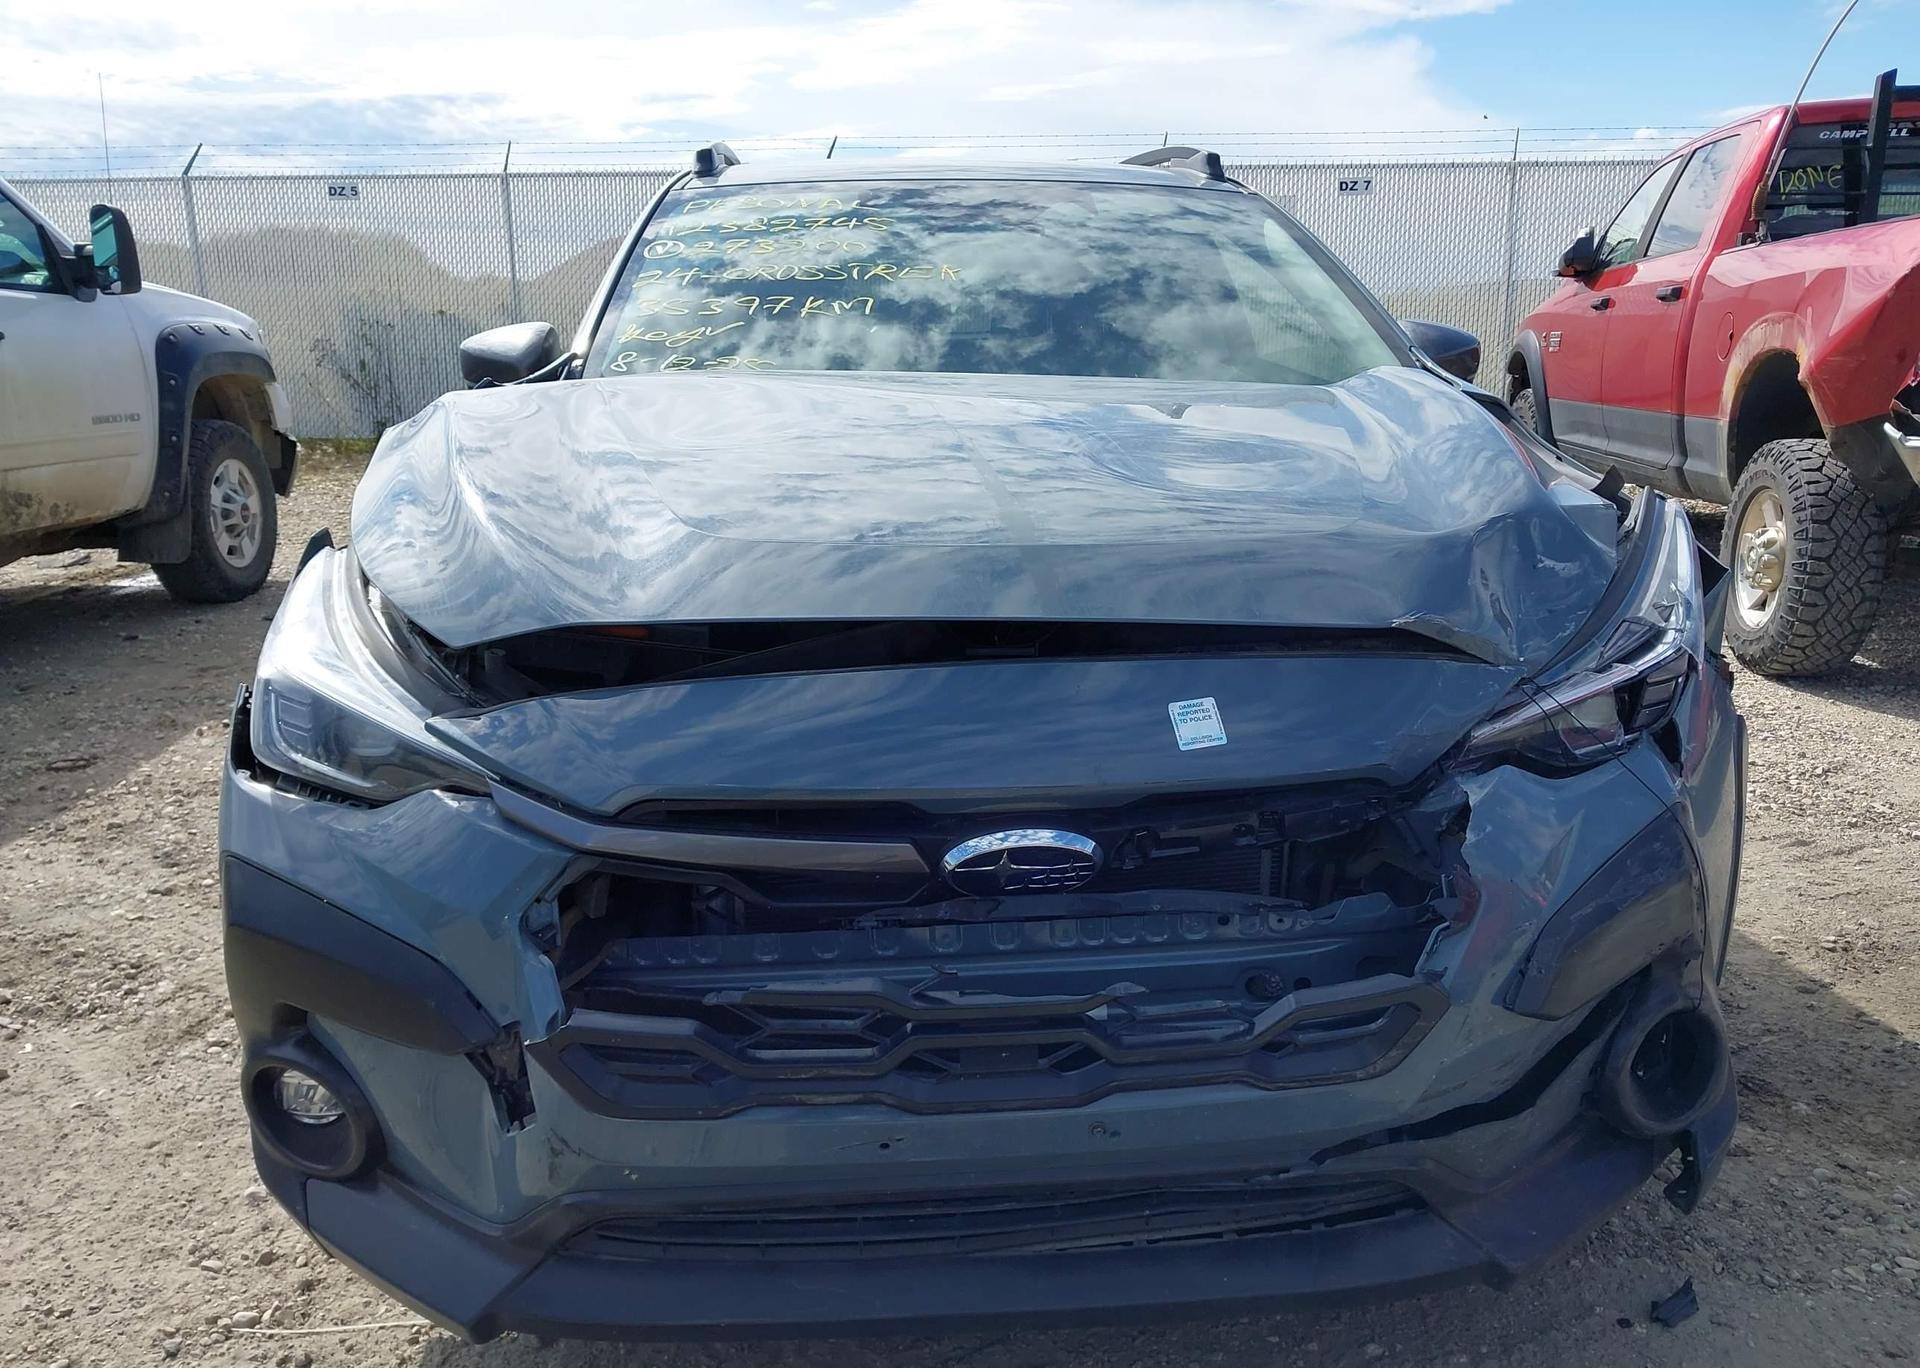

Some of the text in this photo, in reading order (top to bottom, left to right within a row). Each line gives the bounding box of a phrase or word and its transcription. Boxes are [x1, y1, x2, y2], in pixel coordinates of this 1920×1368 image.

[1819, 128, 1911, 139] CAMPLL
[1778, 164, 1842, 193] DONE
[1339, 180, 1372, 191] DZ 7
[328, 186, 358, 197] DZ 5
[1178, 702, 1204, 710] DAMAGE
[1177, 708, 1210, 717] REPORTED
[1189, 714, 1214, 723] POLICE
